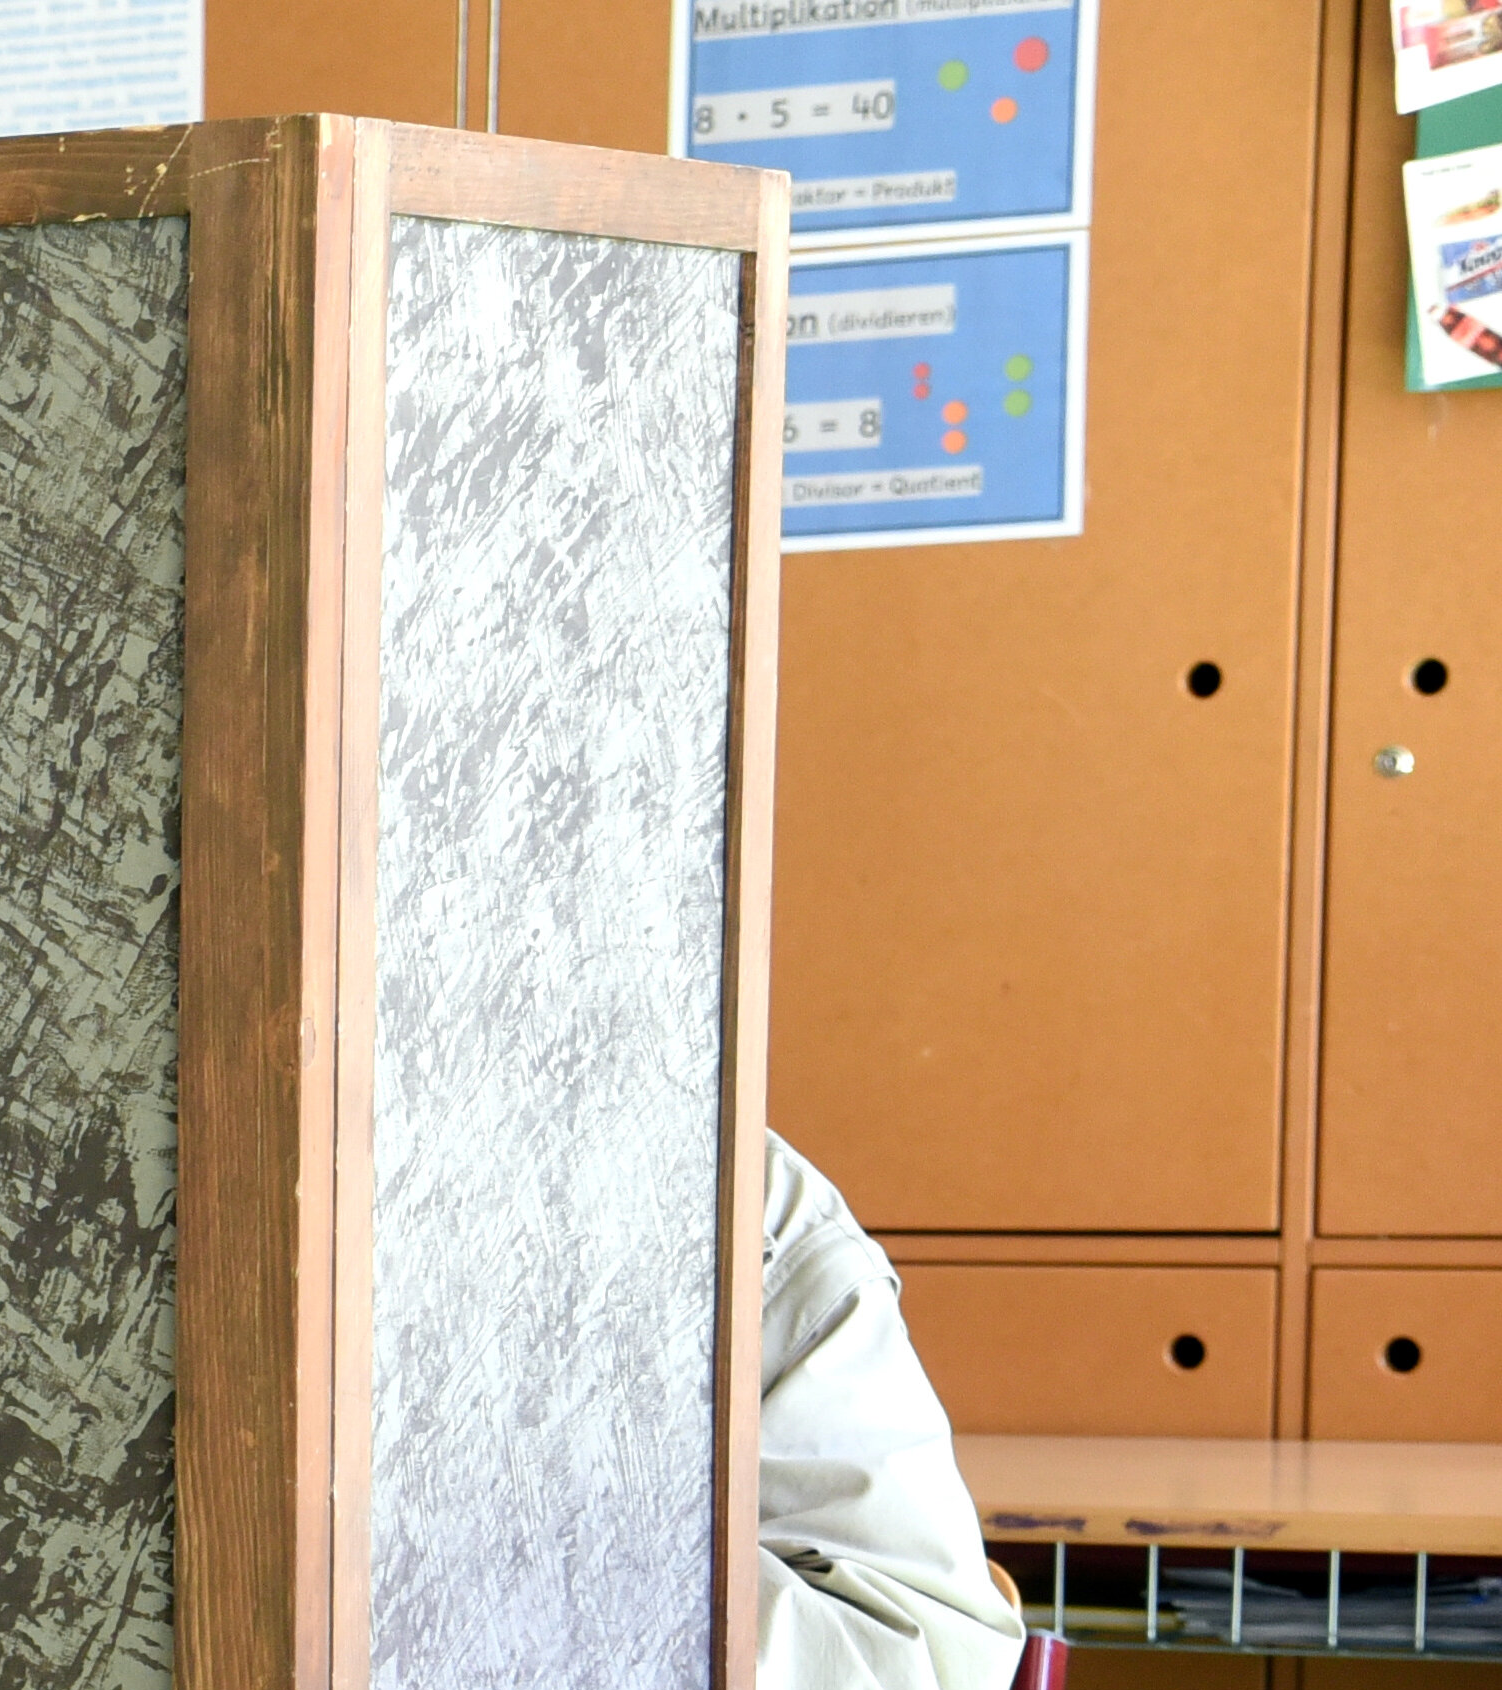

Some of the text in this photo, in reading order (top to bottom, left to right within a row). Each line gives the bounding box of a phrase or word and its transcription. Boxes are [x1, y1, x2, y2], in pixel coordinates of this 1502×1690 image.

[695, 0, 899, 33] Multiplikation
[694, 104, 715, 135] 8
[770, 98, 790, 129] 5
[851, 89, 895, 121] 40
[857, 407, 881, 439] 8
